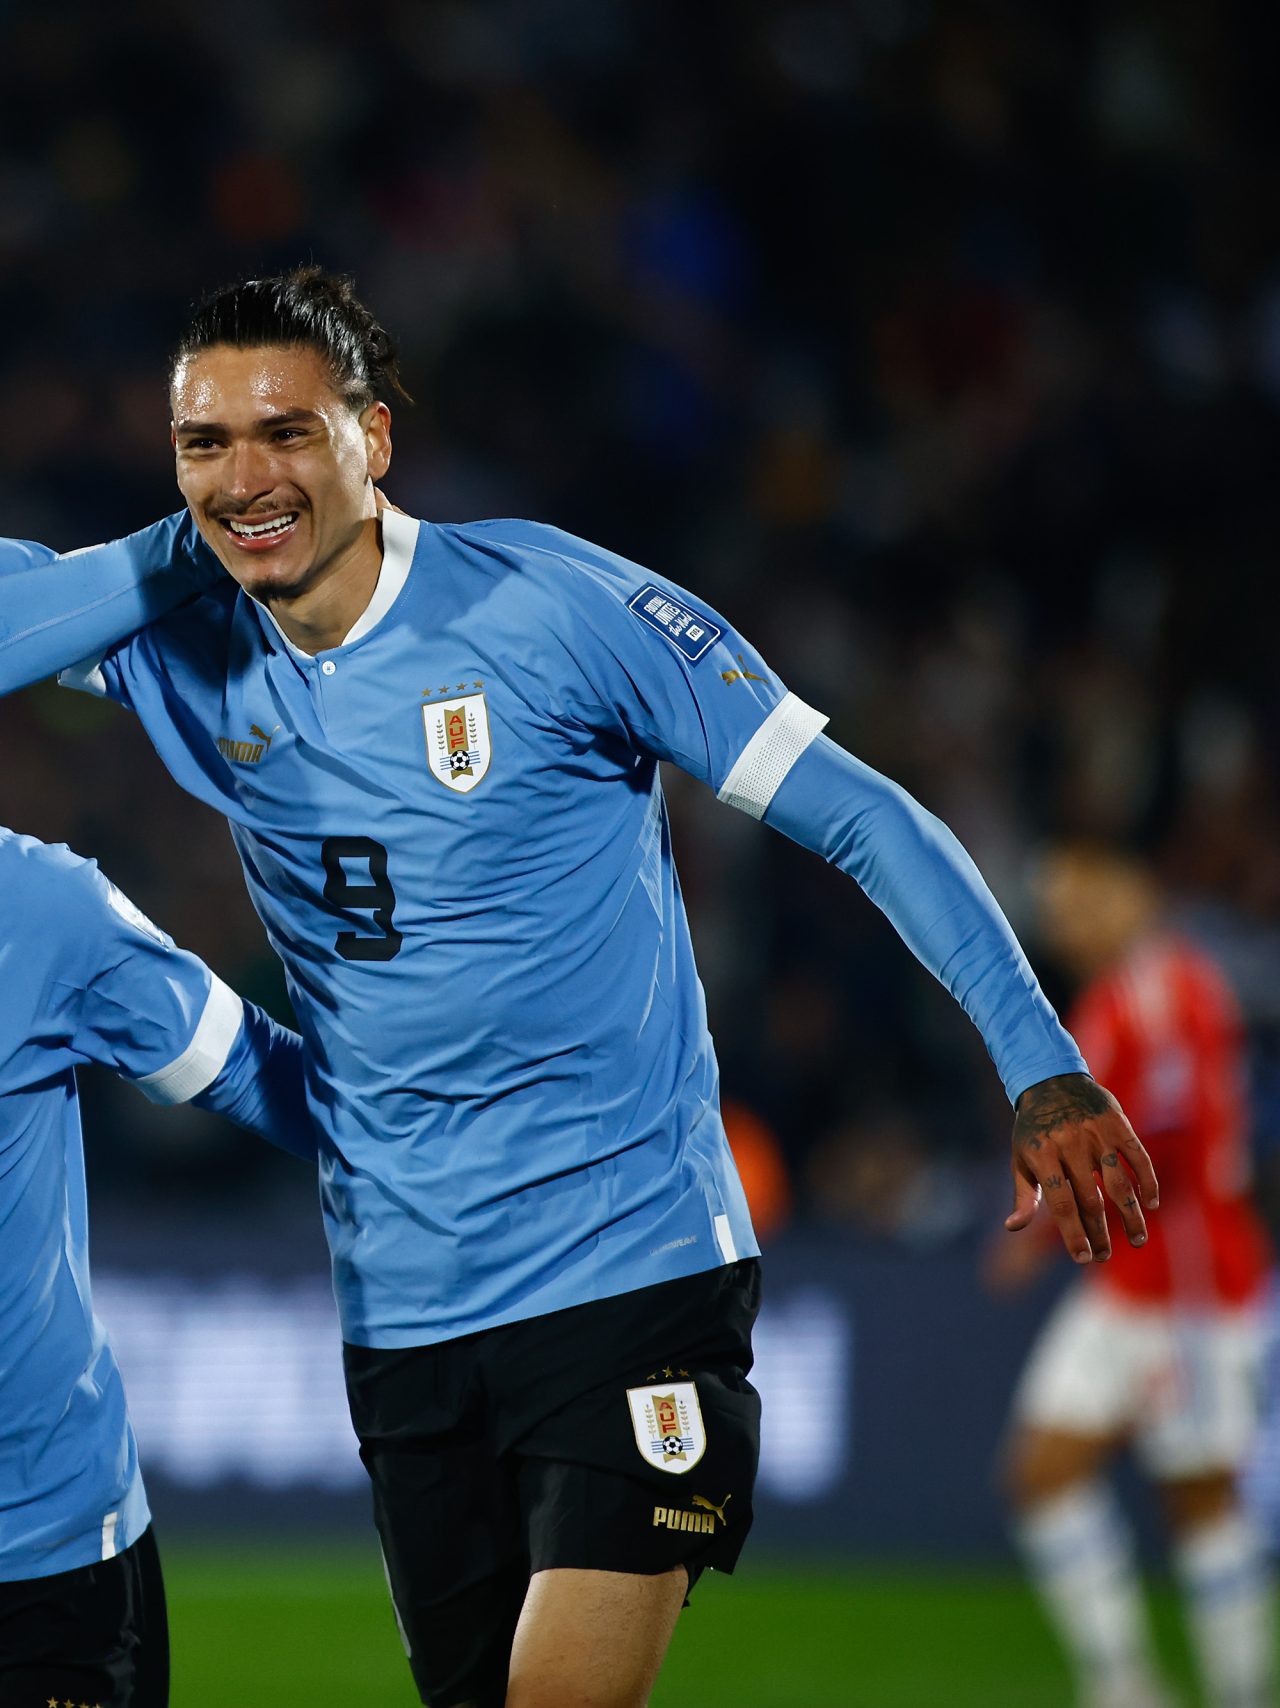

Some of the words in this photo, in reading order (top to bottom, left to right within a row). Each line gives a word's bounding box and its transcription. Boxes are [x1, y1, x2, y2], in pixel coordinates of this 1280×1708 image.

[653, 602, 681, 626] UNITES
[449, 714, 465, 749] AUF
[321, 836, 403, 961] 9
[658, 1401, 677, 1434] AUF
[652, 1506, 715, 1534] PUMA
